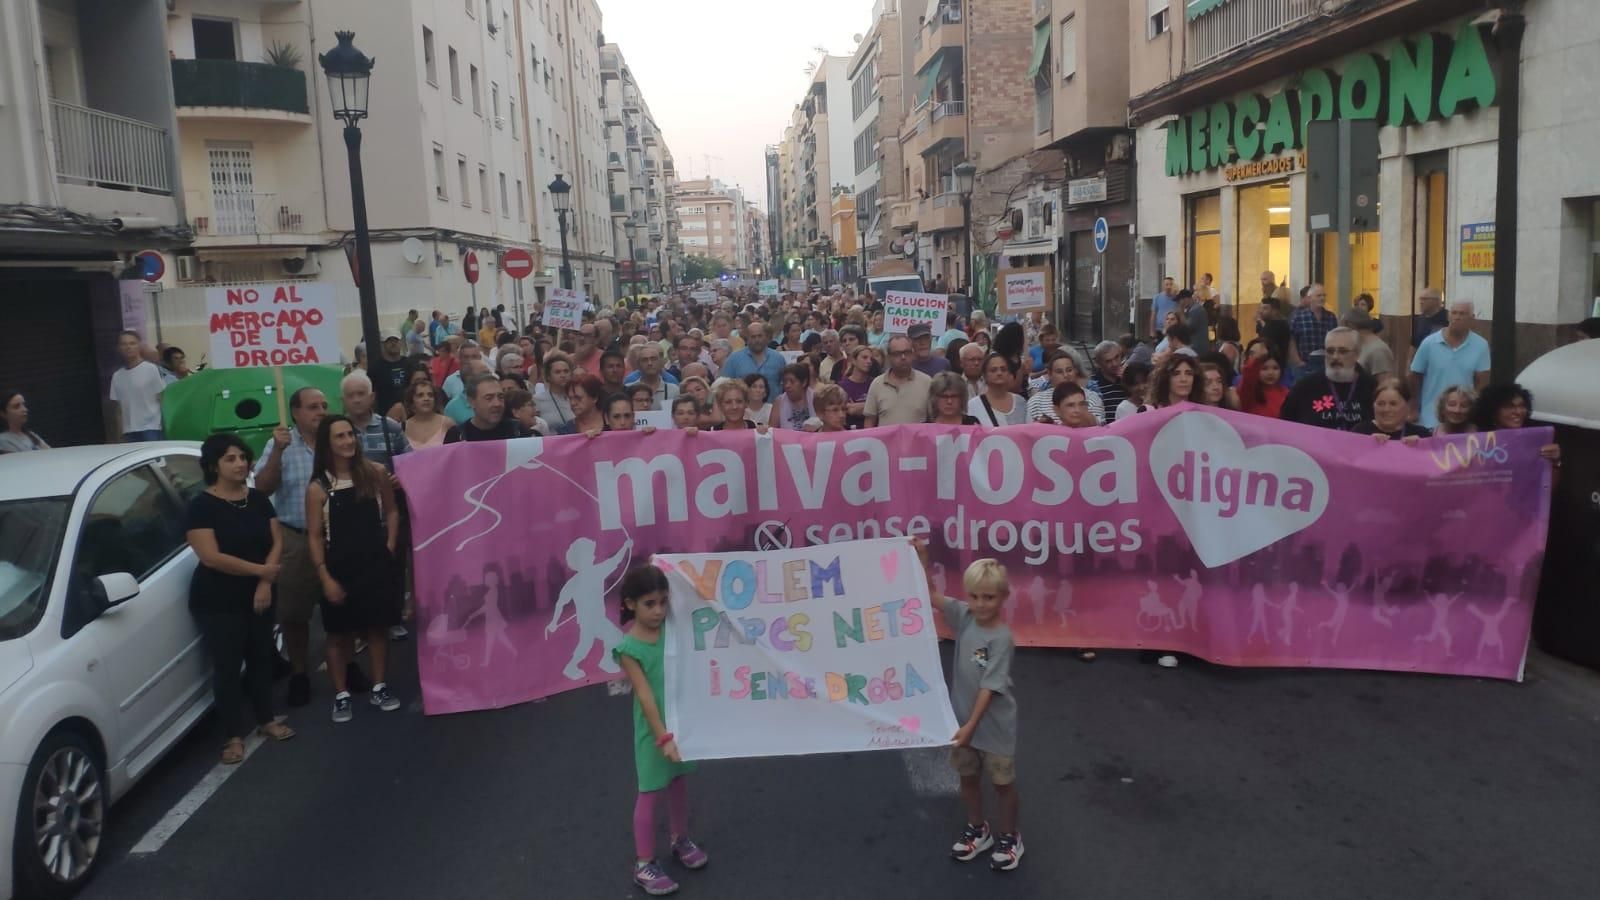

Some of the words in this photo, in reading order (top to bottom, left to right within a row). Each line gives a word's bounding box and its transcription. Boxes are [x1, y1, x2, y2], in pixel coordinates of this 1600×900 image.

[1165, 23, 1496, 177] MERCADONA
[1224, 157, 1292, 182] SUPERMERCADOS
[227, 288, 259, 305] NO
[273, 286, 303, 304] AL
[887, 306, 939, 319] CASITAS
[210, 308, 323, 333] MERCADO
[230, 330, 261, 347] DE
[276, 327, 308, 344] LA
[235, 346, 319, 367] DROGA
[594, 427, 1138, 530] malva-rosa
[1167, 450, 1314, 518] digna
[806, 514, 931, 545] sense
[943, 505, 1142, 566] drogues
[679, 555, 846, 611] VOLEM
[691, 607, 814, 651] PARCS
[833, 597, 924, 648] NETS
[729, 666, 816, 700] SENSE
[824, 662, 931, 705] DROGA
